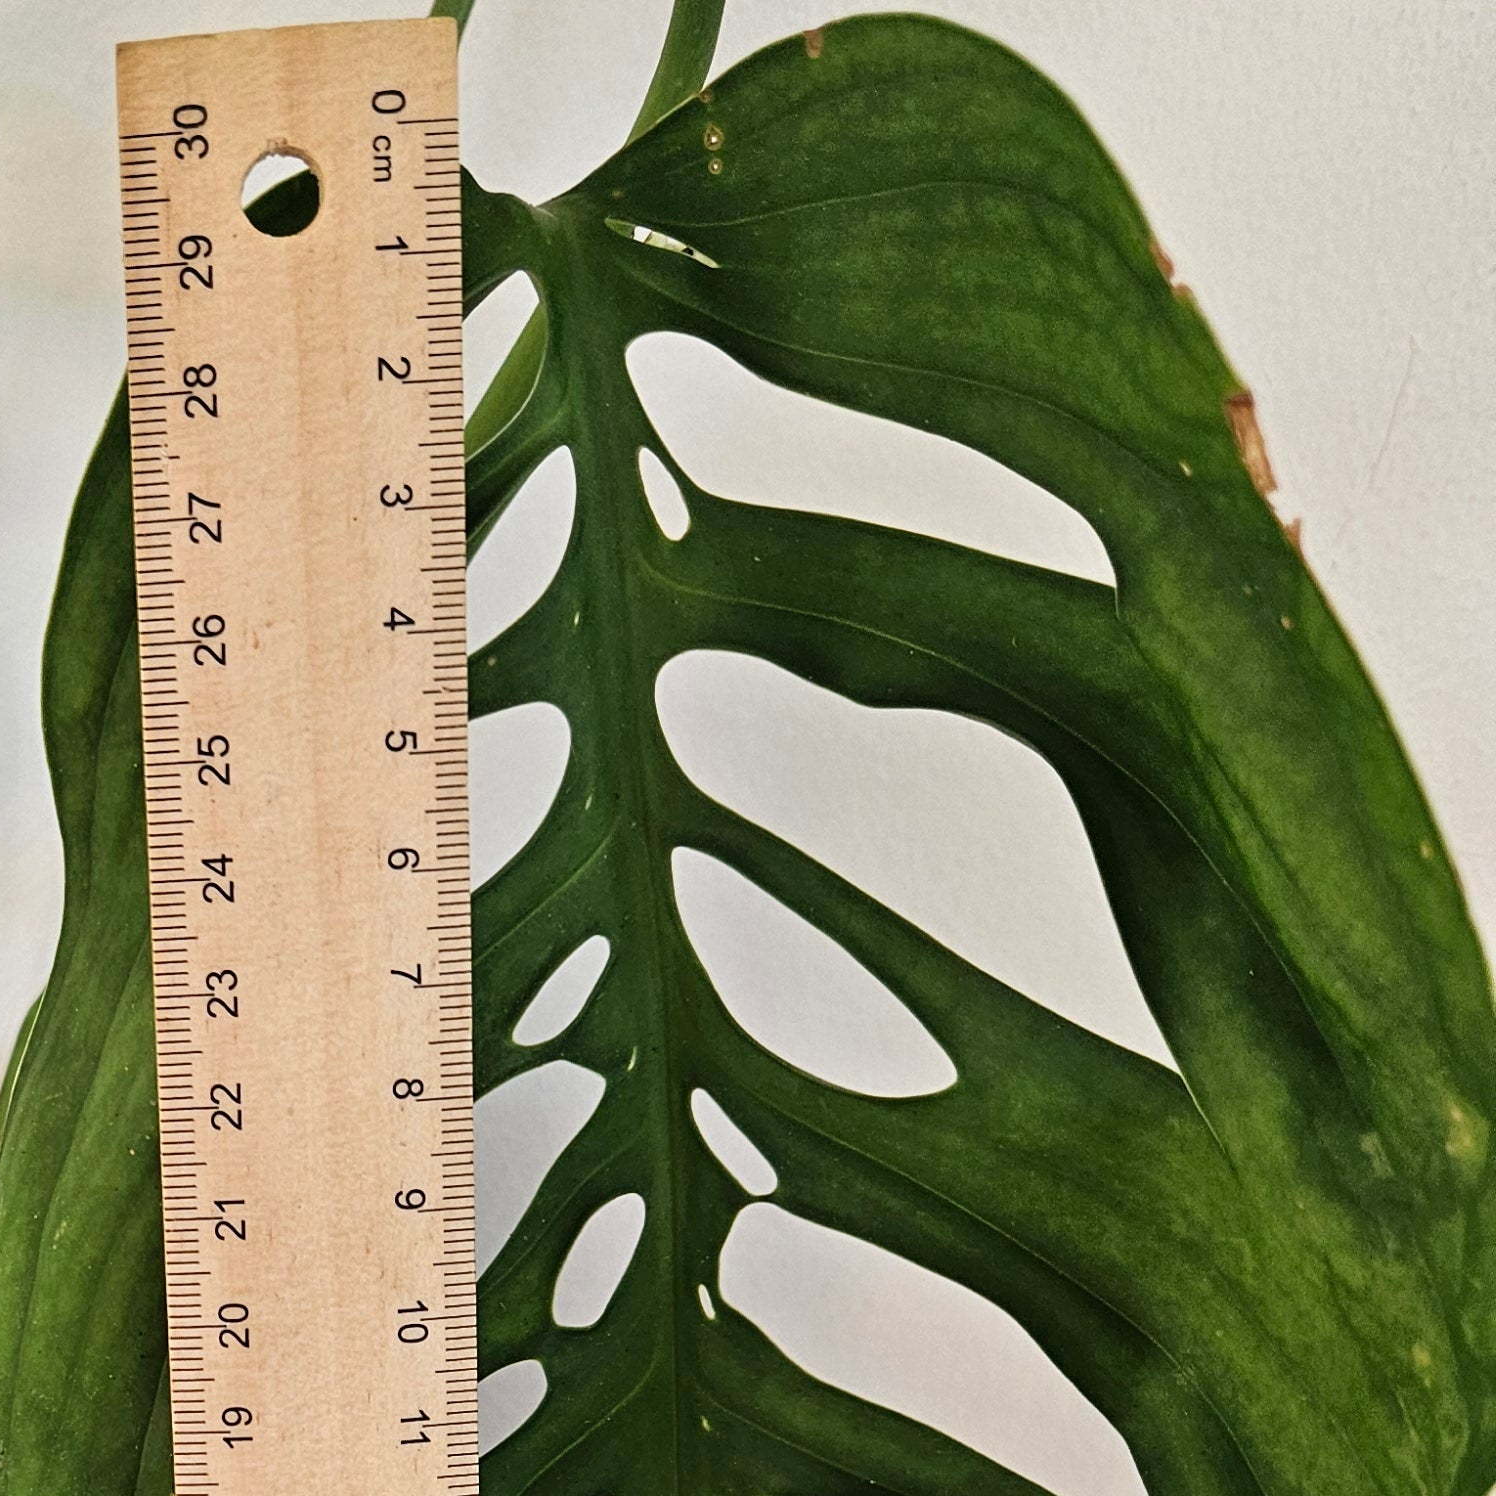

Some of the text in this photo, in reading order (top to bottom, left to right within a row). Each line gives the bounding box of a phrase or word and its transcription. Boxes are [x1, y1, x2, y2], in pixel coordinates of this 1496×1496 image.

[371, 90, 406, 114] 0
[173, 104, 209, 160] 30
[372, 135, 392, 182] cm
[178, 235, 214, 290] 29
[374, 236, 409, 251] 1
[377, 357, 411, 381] 2
[183, 364, 219, 418] 28
[380, 484, 413, 508] 3
[188, 492, 223, 544] 27
[193, 614, 228, 667] 26
[382, 607, 415, 632] 4
[198, 735, 232, 786] 25
[385, 730, 418, 753] 5
[202, 853, 236, 903] 24
[387, 847, 420, 870] 6
[207, 969, 240, 1018] 23
[390, 965, 422, 985] 7
[211, 1083, 245, 1131] 22
[392, 1078, 424, 1100] 8
[215, 1199, 249, 1241] 21
[395, 1188, 426, 1211] 9
[220, 1303, 253, 1348] 20
[398, 1300, 429, 1344] 10
[224, 1406, 256, 1449] 19
[400, 1410, 431, 1446] 11
